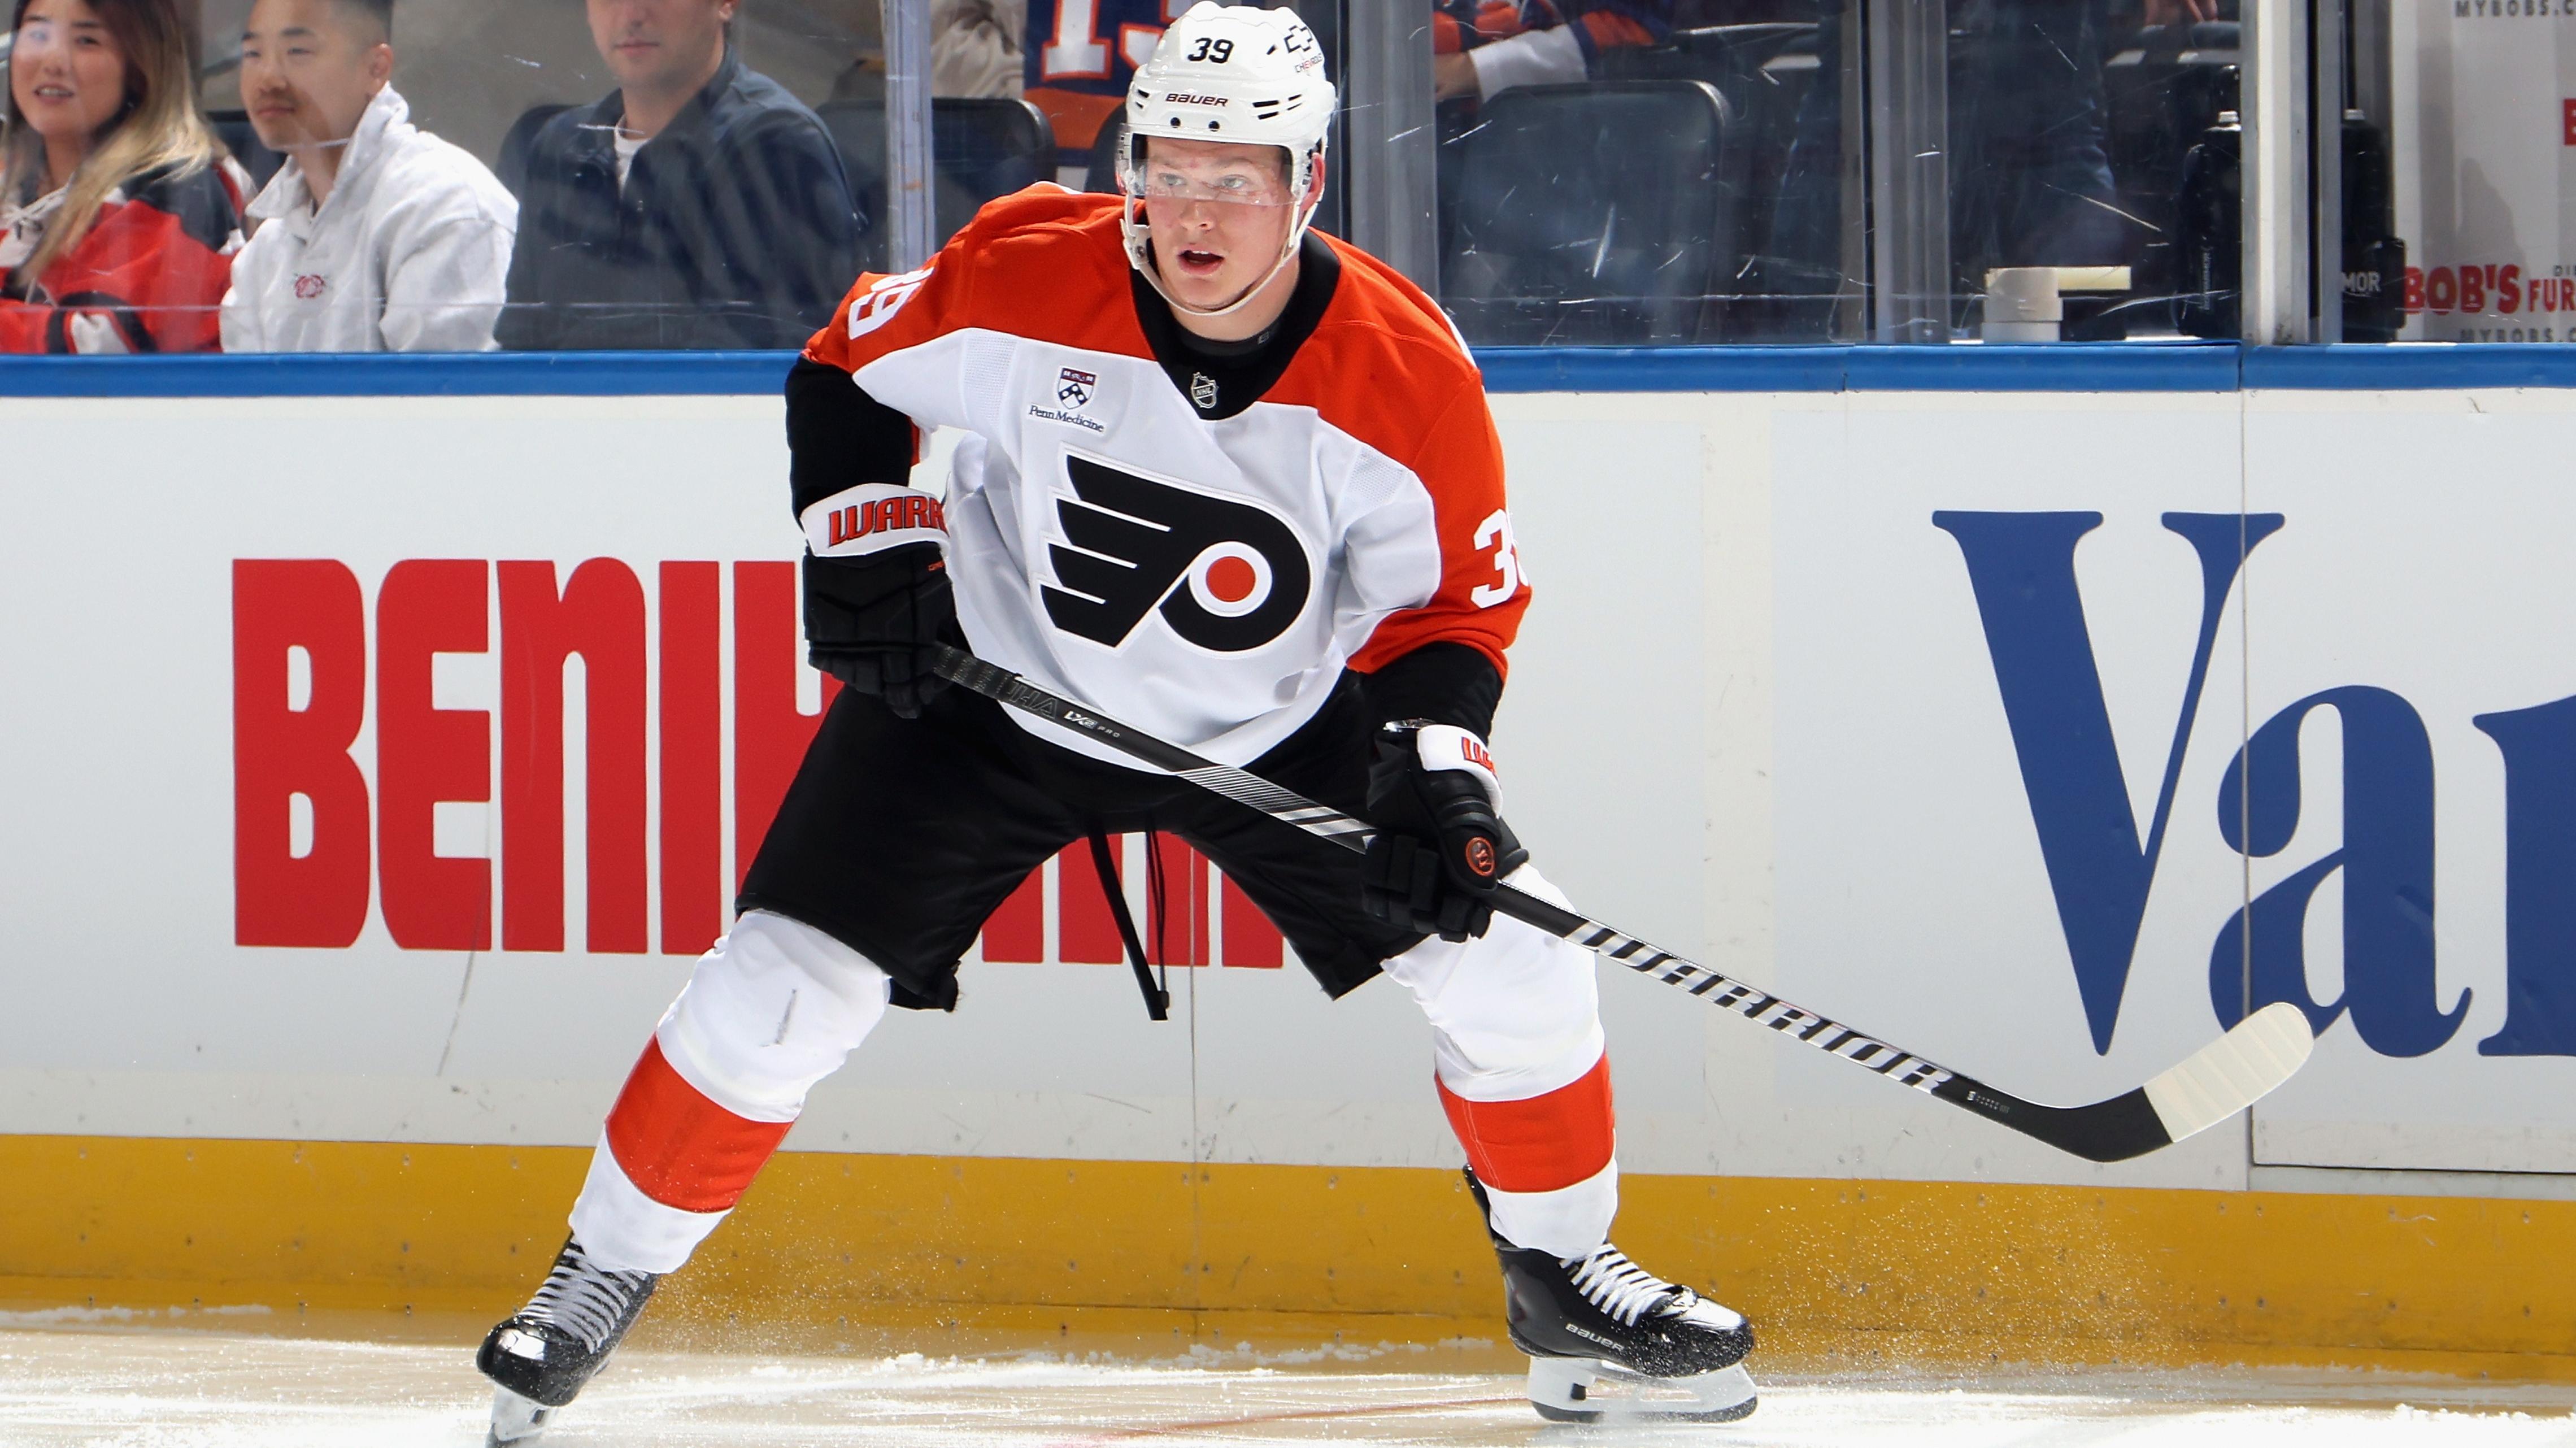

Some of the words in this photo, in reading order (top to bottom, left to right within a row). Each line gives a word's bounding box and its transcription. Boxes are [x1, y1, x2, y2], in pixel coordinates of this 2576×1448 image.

[1188, 38, 1234, 64] 39
[1165, 93, 1228, 107] BAUER
[2554, 264, 2576, 276] DI
[2404, 263, 2522, 315] BOB'S
[1029, 405, 1055, 419] Penn
[1055, 410, 1104, 432] Medicine
[1097, 725, 1121, 738] PRO
